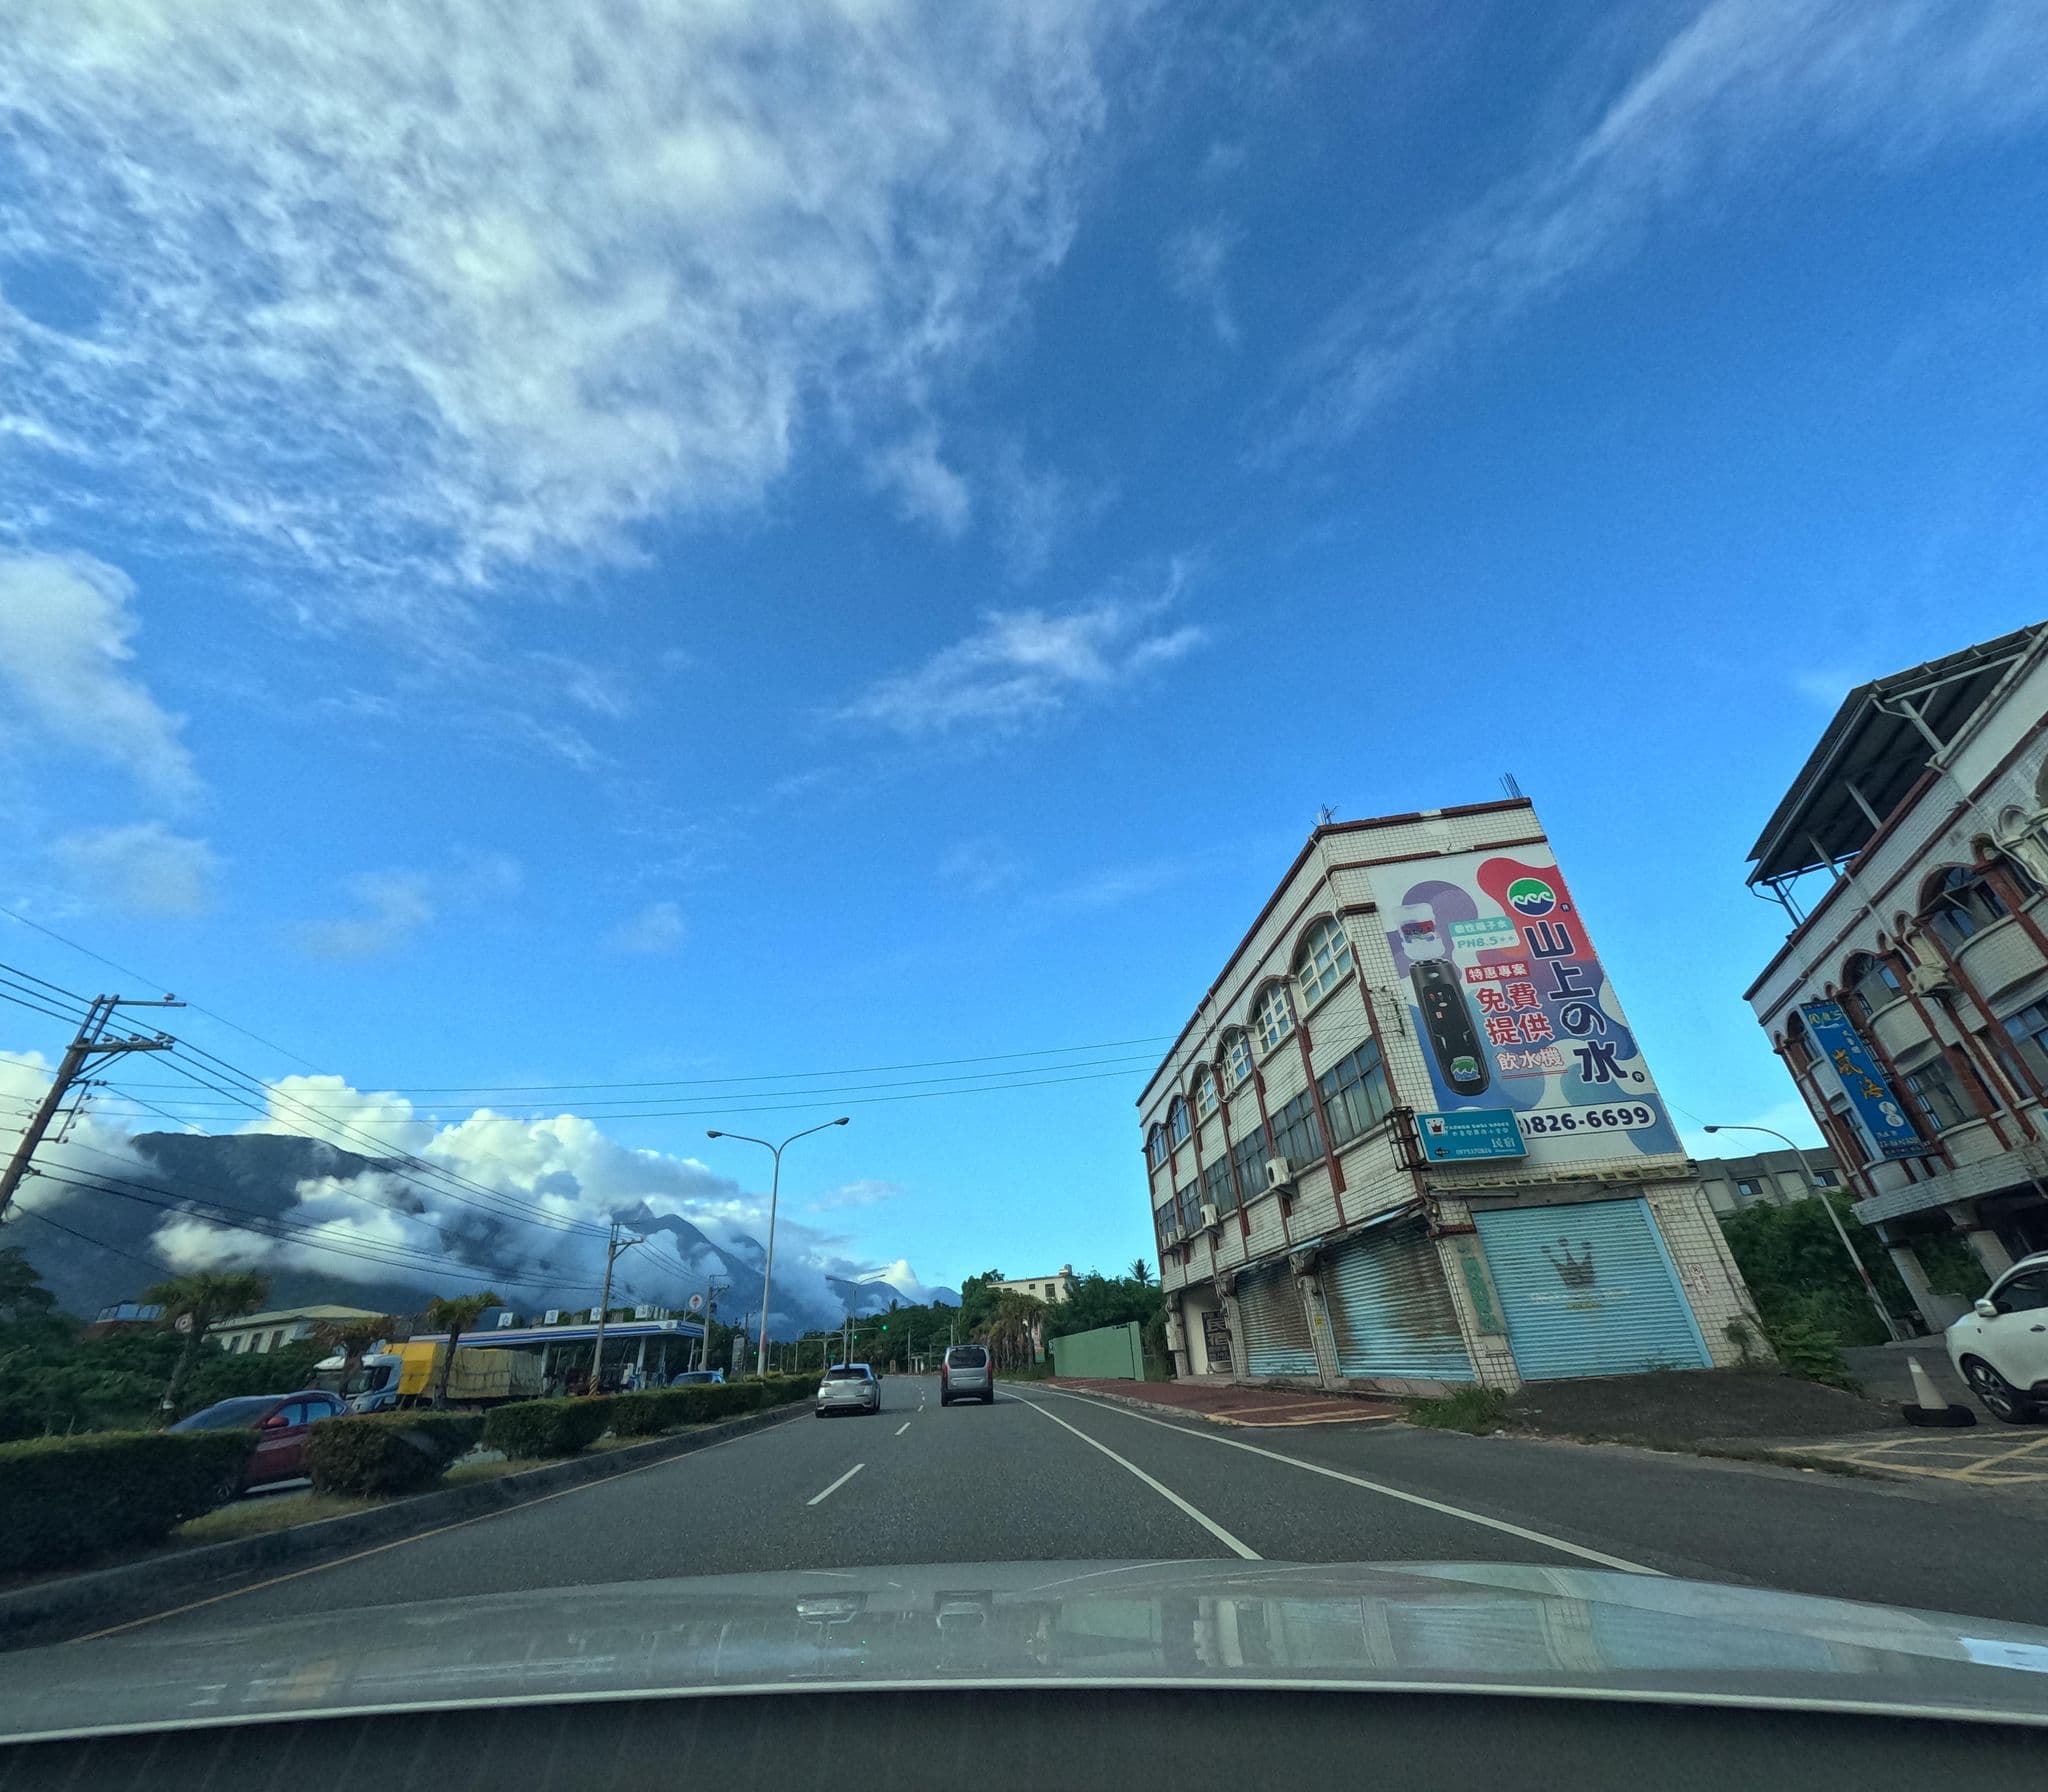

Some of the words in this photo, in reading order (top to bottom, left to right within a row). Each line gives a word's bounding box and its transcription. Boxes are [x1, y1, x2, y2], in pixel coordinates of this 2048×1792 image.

[1468, 963, 1528, 981] 特惠專案
[1476, 982, 1541, 1014] 免費
[1523, 920, 1628, 1084] 山上の水
[1485, 1013, 1554, 1045] 提供
[1497, 1047, 1564, 1070] 飲水機
